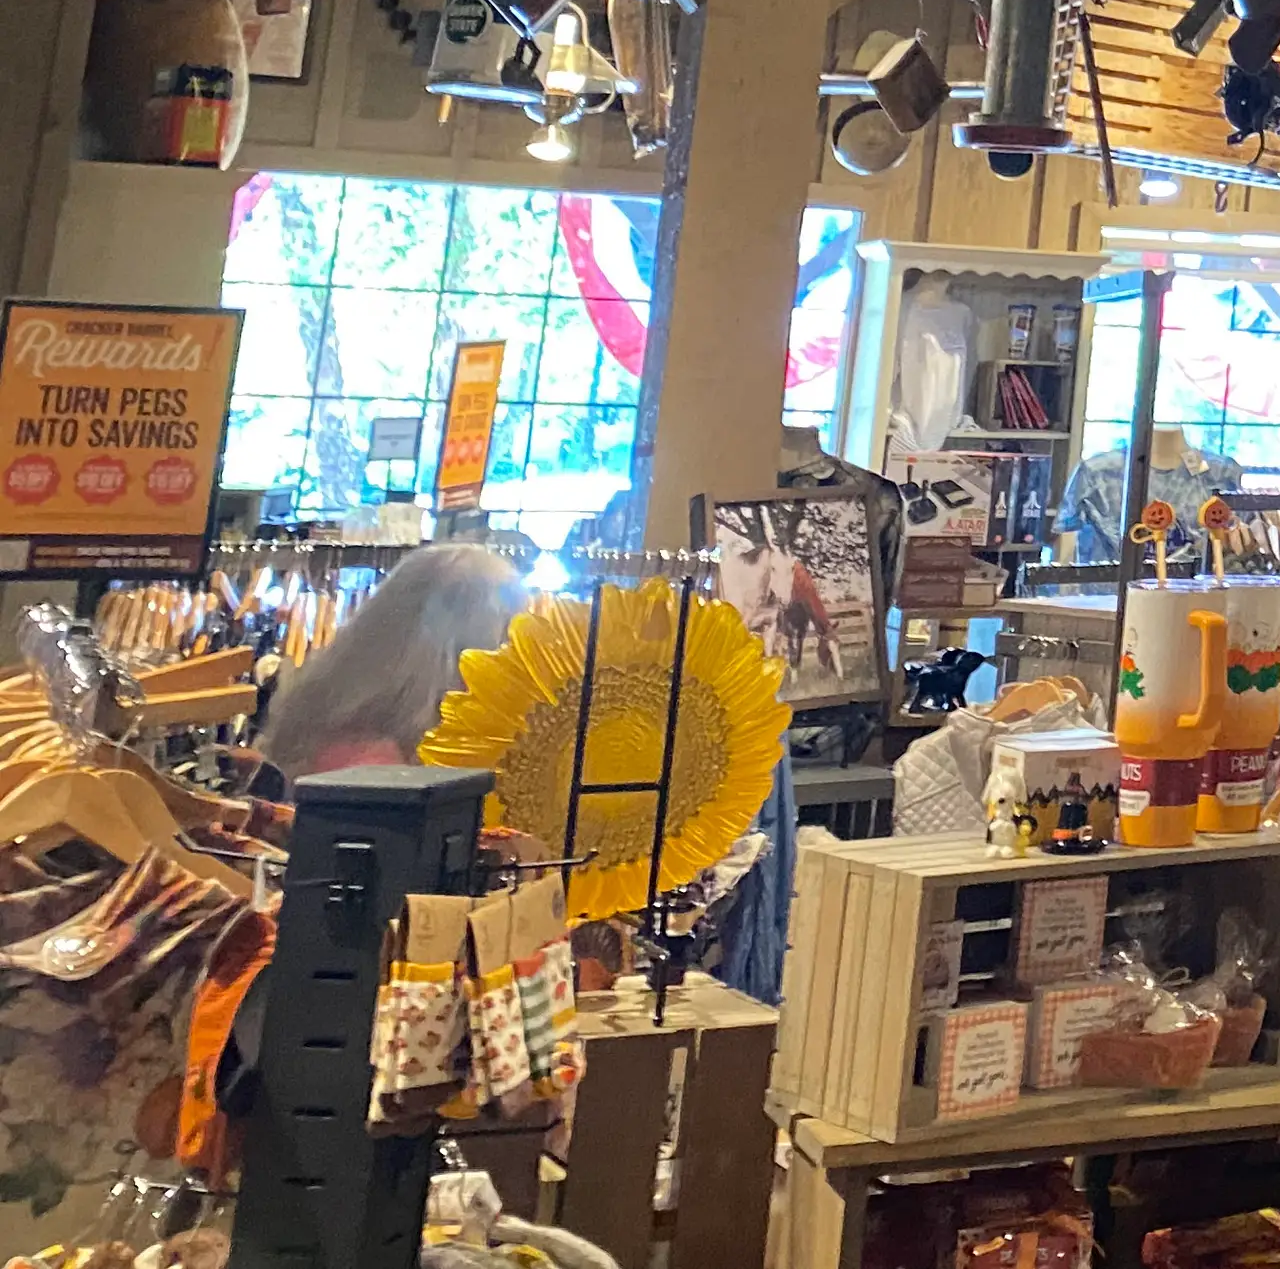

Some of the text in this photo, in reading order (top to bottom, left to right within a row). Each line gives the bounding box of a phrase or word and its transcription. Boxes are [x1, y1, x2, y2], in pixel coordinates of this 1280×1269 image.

[13, 318, 203, 379] Rewards
[38, 384, 190, 417] TURN PEGS
[15, 417, 200, 450] INTO SAVINGS
[957, 519, 985, 532] ATARI
